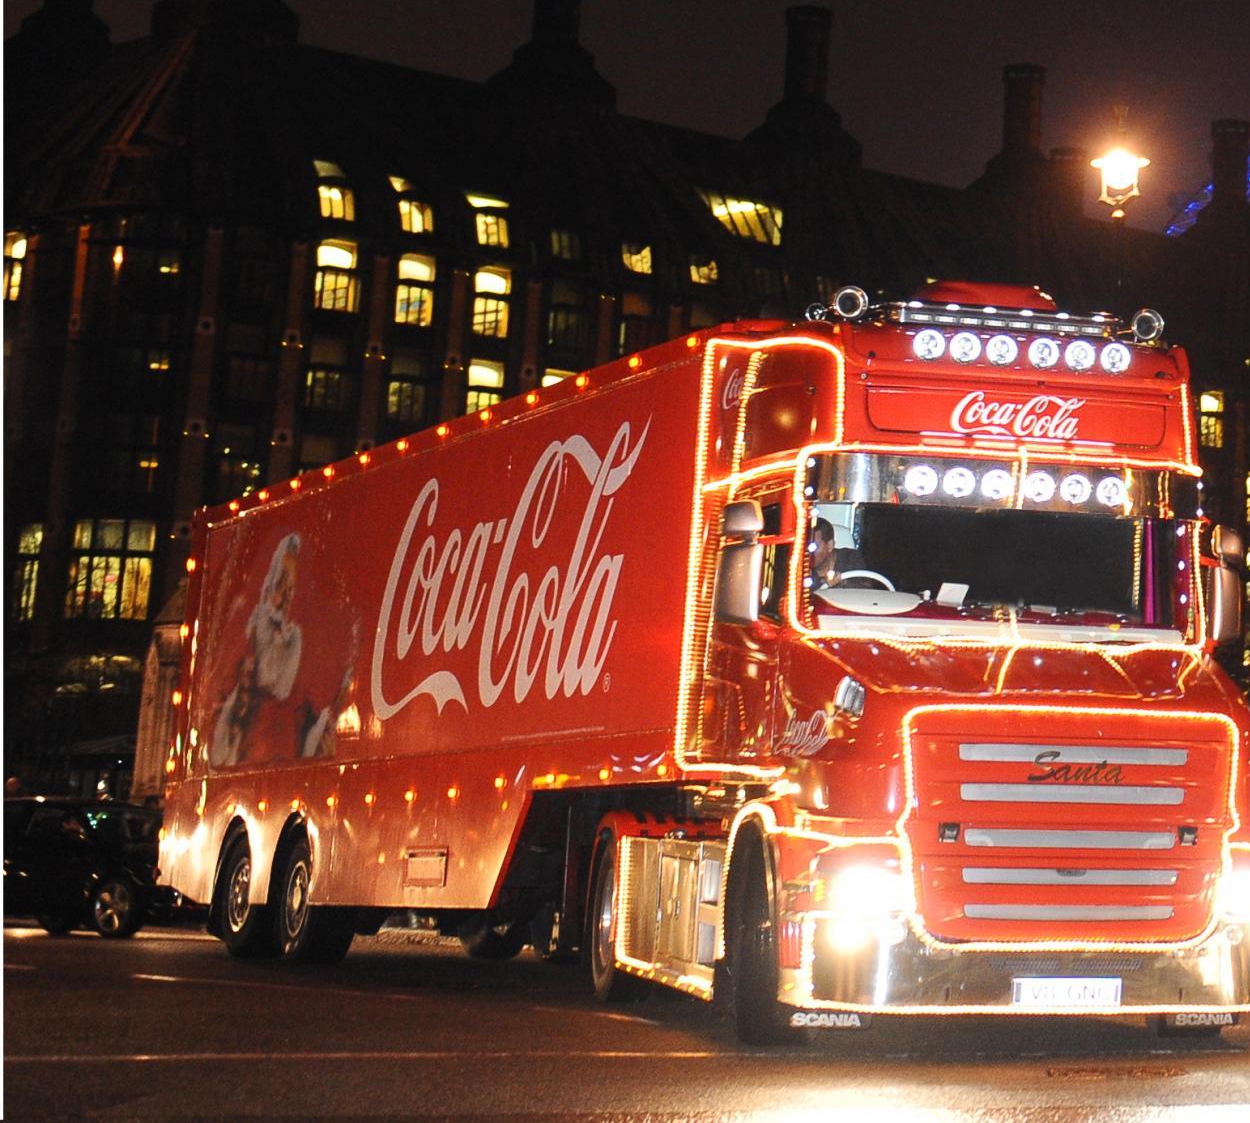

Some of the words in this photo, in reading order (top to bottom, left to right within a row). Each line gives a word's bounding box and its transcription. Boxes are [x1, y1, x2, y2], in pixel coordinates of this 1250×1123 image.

[949, 390, 1087, 439] Coca-Cola
[371, 412, 653, 721] Coca-Cola
[1027, 750, 1124, 784] Santa
[790, 1011, 861, 1027] SCANIA
[1175, 1012, 1234, 1026] SCANIA
